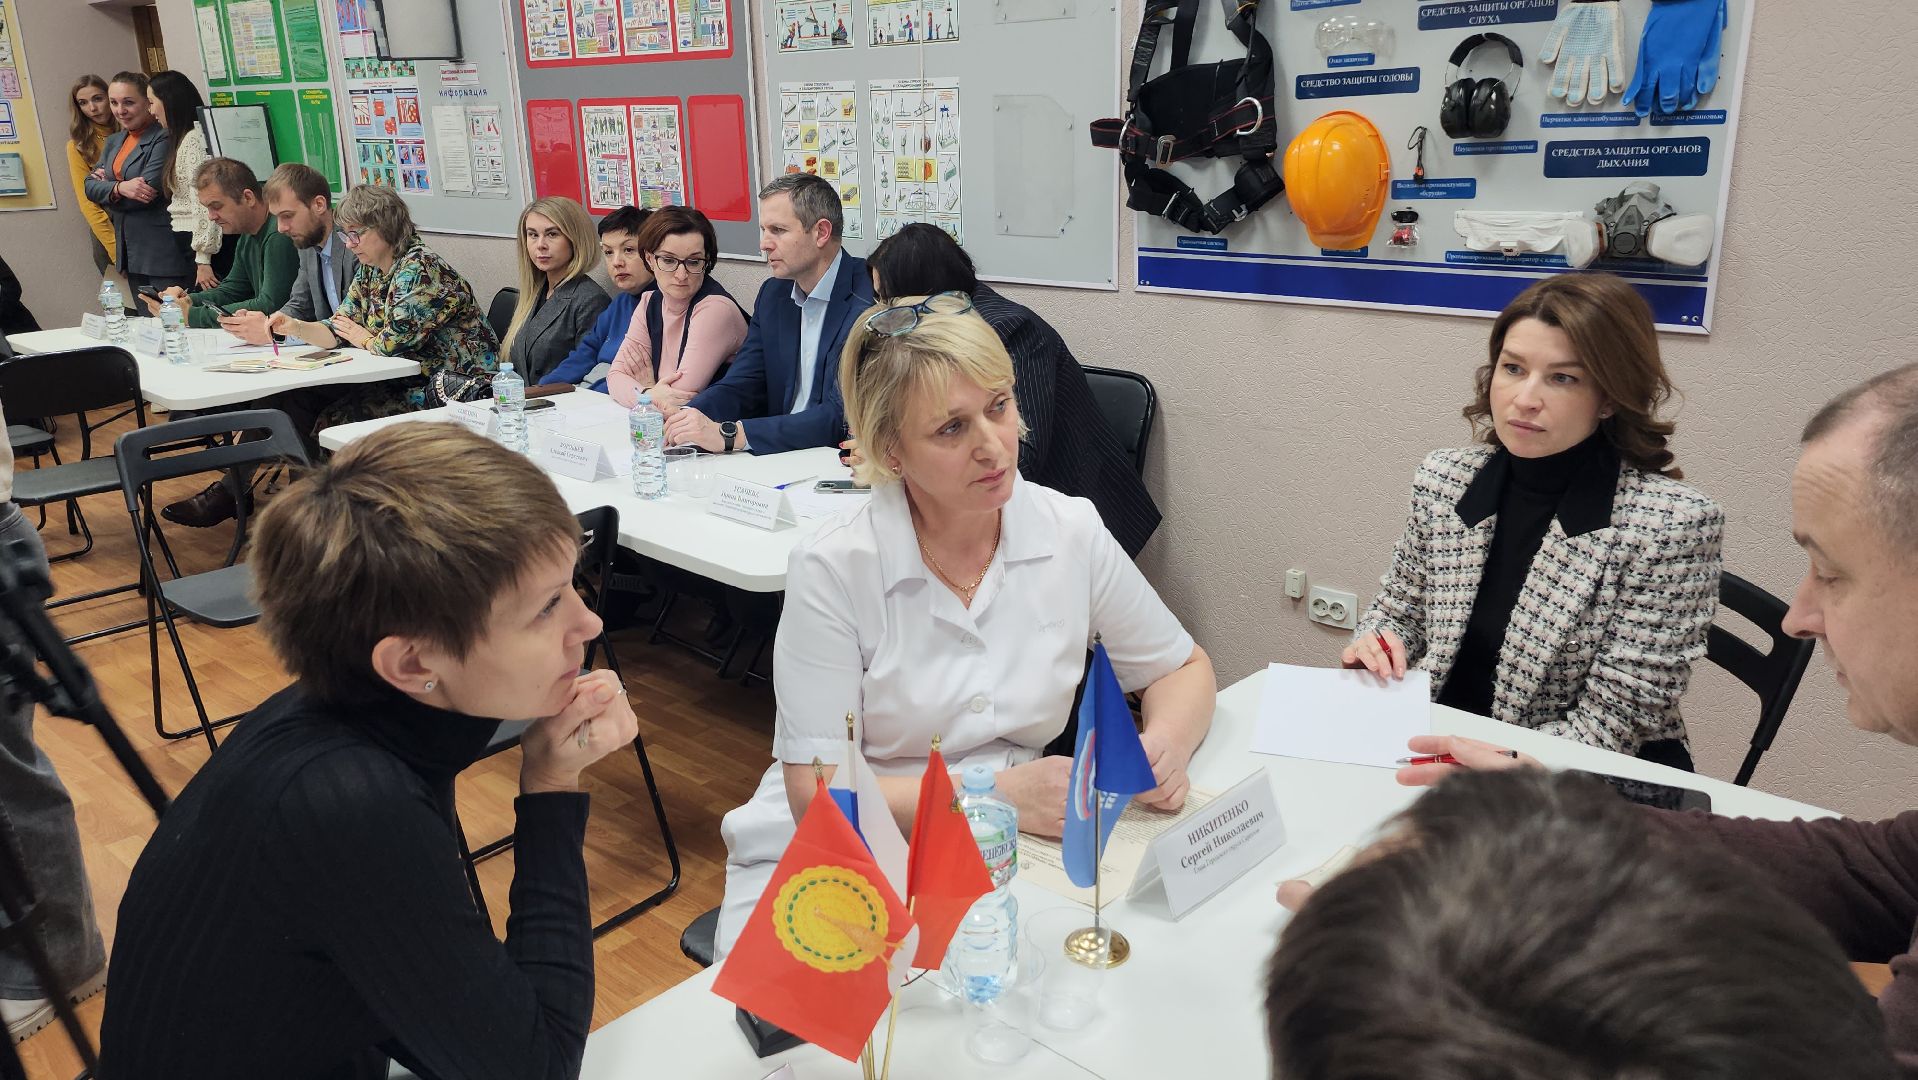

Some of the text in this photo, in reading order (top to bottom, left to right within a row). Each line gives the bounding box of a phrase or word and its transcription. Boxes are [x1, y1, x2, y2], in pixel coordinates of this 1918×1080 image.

[1421, 0, 1555, 17] СРЕДСТВА ЗАЩИТЫ ОРГАНОВ
[1469, 15, 1502, 25] СЛУХА
[1300, 72, 1413, 88] СРЕДСТВО ЗАЩИТЫ ГОЛОВЫ
[1551, 145, 1702, 157] СРЕДСТВА ЗАЩИТЫ ОРГАНОВ
[1597, 158, 1649, 168] ДЫХАНИЯ
[1187, 799, 1249, 845] НИКИТЕНКО
[1180, 840, 1213, 868] Сергей
[1212, 811, 1264, 848] Николаевич
